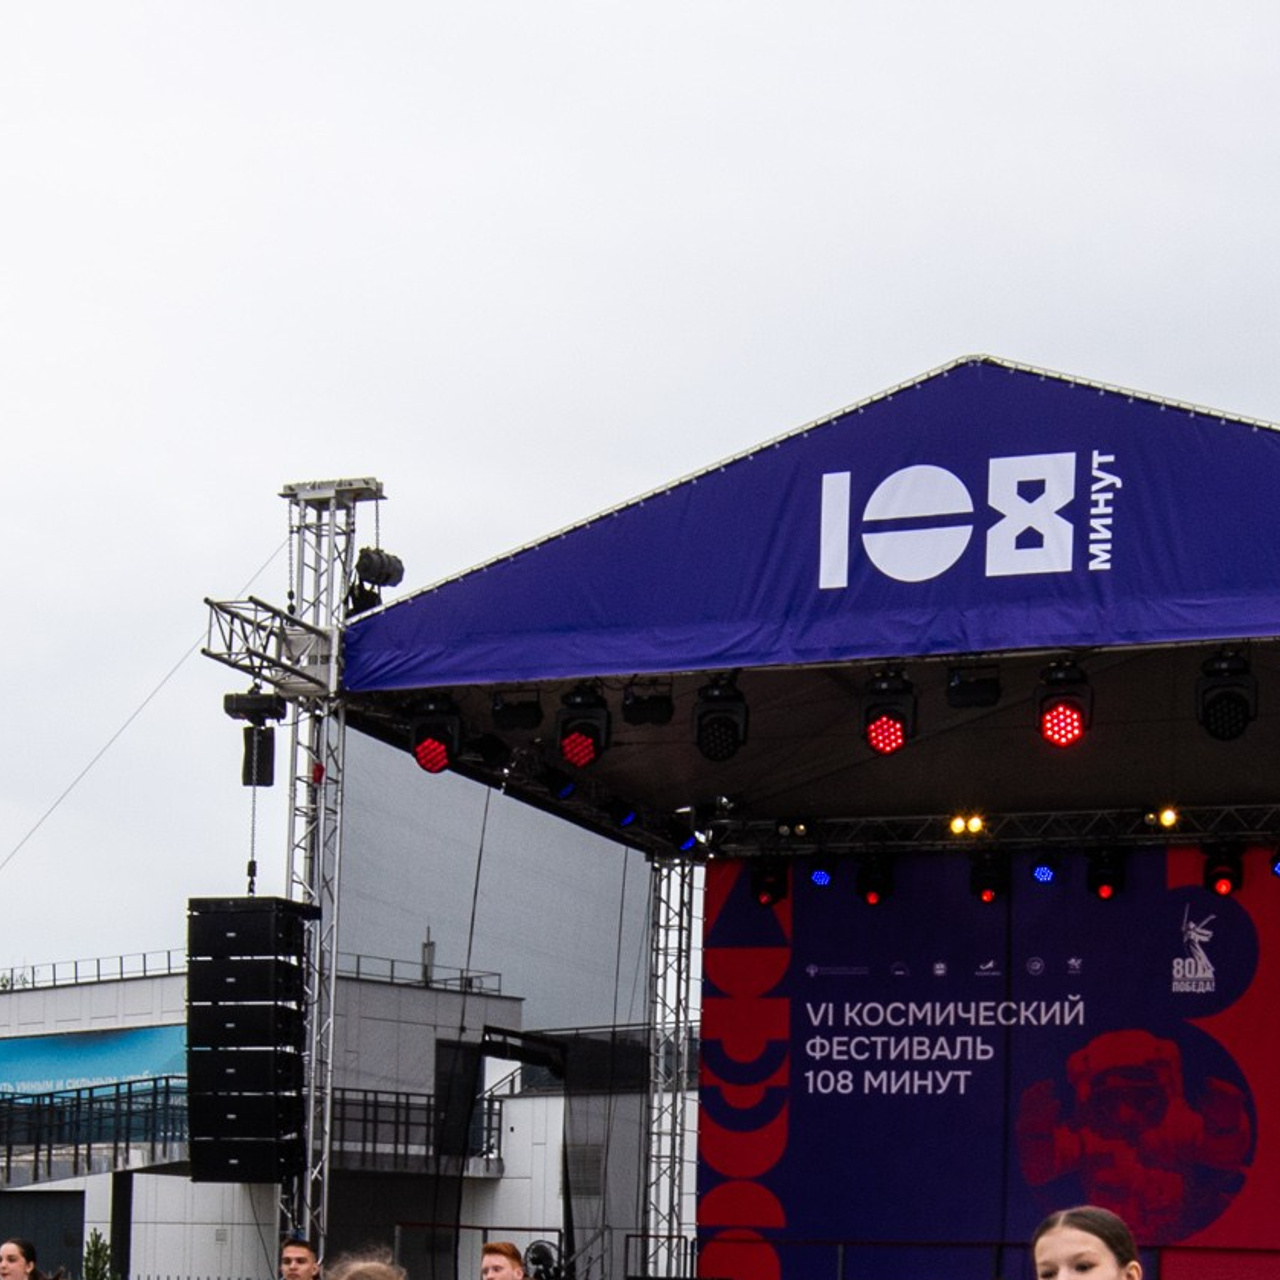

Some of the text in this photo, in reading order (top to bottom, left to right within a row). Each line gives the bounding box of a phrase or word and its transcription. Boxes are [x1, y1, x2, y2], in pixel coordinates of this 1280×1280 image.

[819, 452, 1076, 589] 108
[806, 994, 1085, 1026] VI КОСМИЧЕСКИЙ
[805, 1035, 995, 1061] ФЕСТИВАЛЬ
[804, 1070, 972, 1094] 108 МИНУТ
